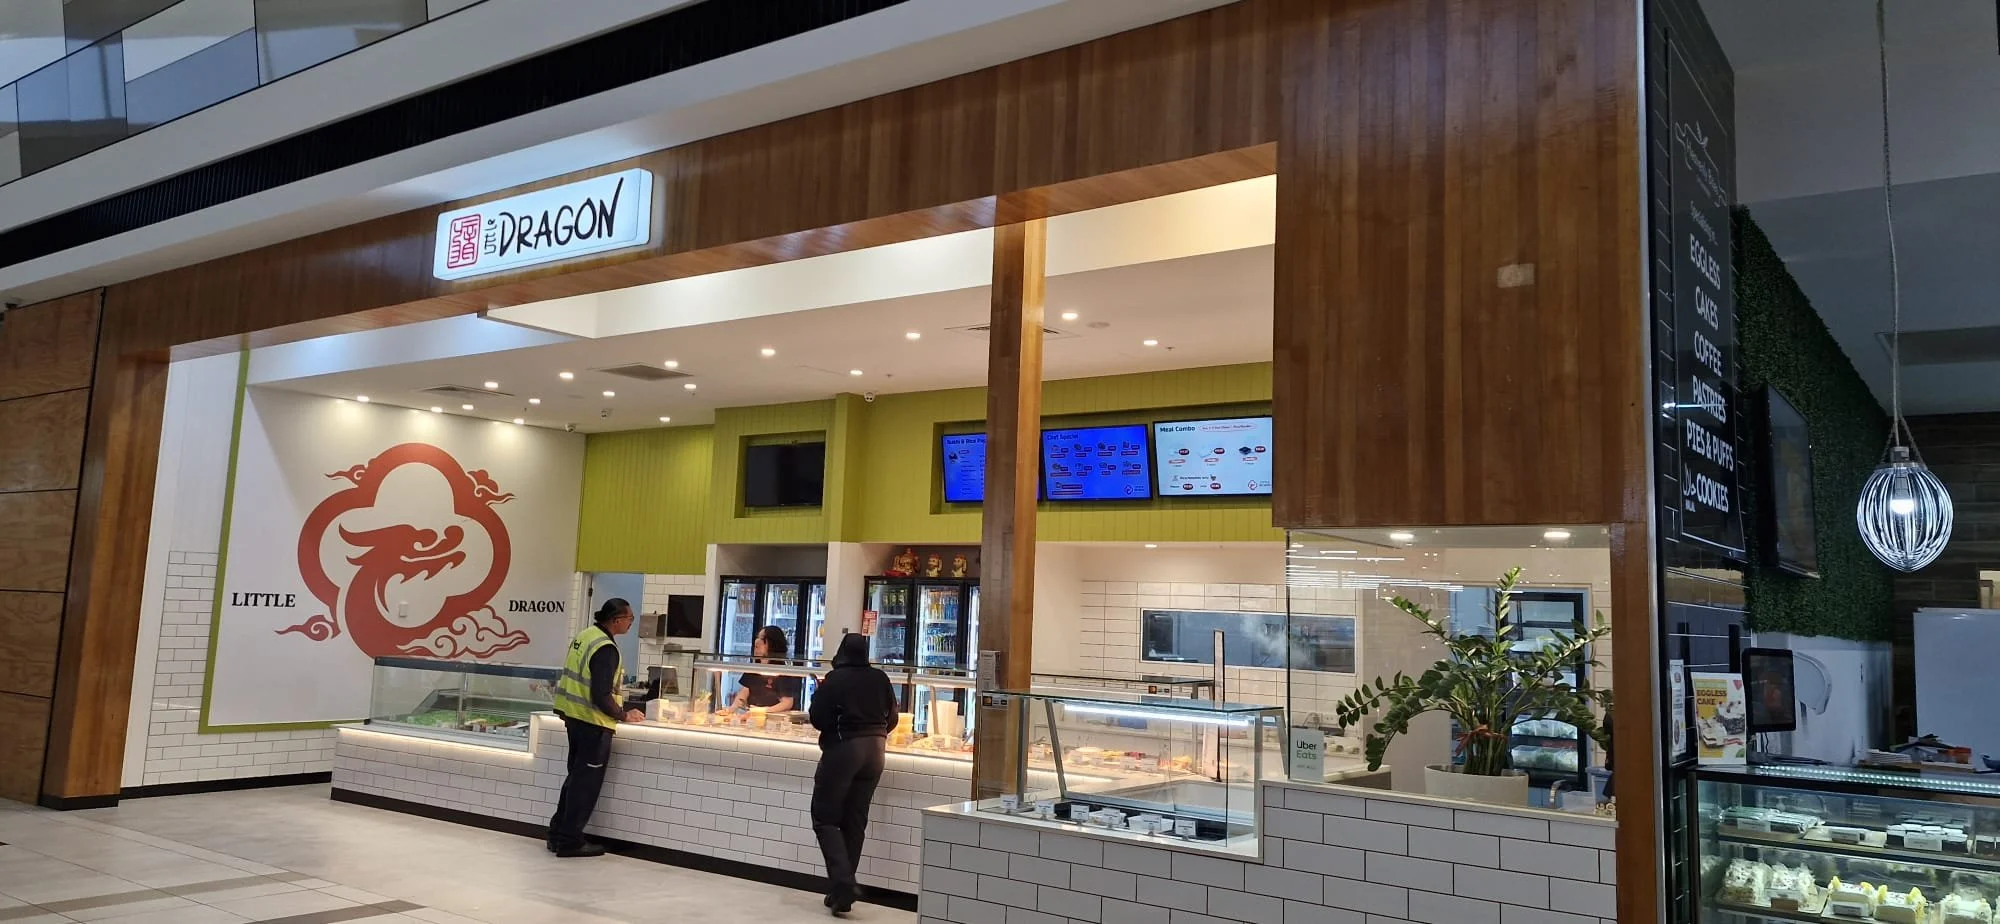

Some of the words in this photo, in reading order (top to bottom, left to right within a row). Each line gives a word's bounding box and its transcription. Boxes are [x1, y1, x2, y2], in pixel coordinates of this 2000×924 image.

[499, 176, 624, 257] DRAGON
[1690, 233, 1721, 291] EGGLESS
[1695, 285, 1719, 331] CAKES
[1694, 330, 1722, 377] COFFEE
[1692, 375, 1727, 425] PASTRIES
[1686, 418, 1704, 456] PIES
[1706, 430, 1712, 461] &
[1713, 434, 1734, 472] PUFFS
[1696, 472, 1729, 513] COOKIES
[232, 592, 296, 608] LITTLE
[508, 600, 565, 613] DRAGON
[1697, 689, 1727, 697] EGGLESS
[1697, 697, 1717, 705] CAKE
[1296, 740, 1317, 750] Uber
[1296, 750, 1317, 760] Eats
